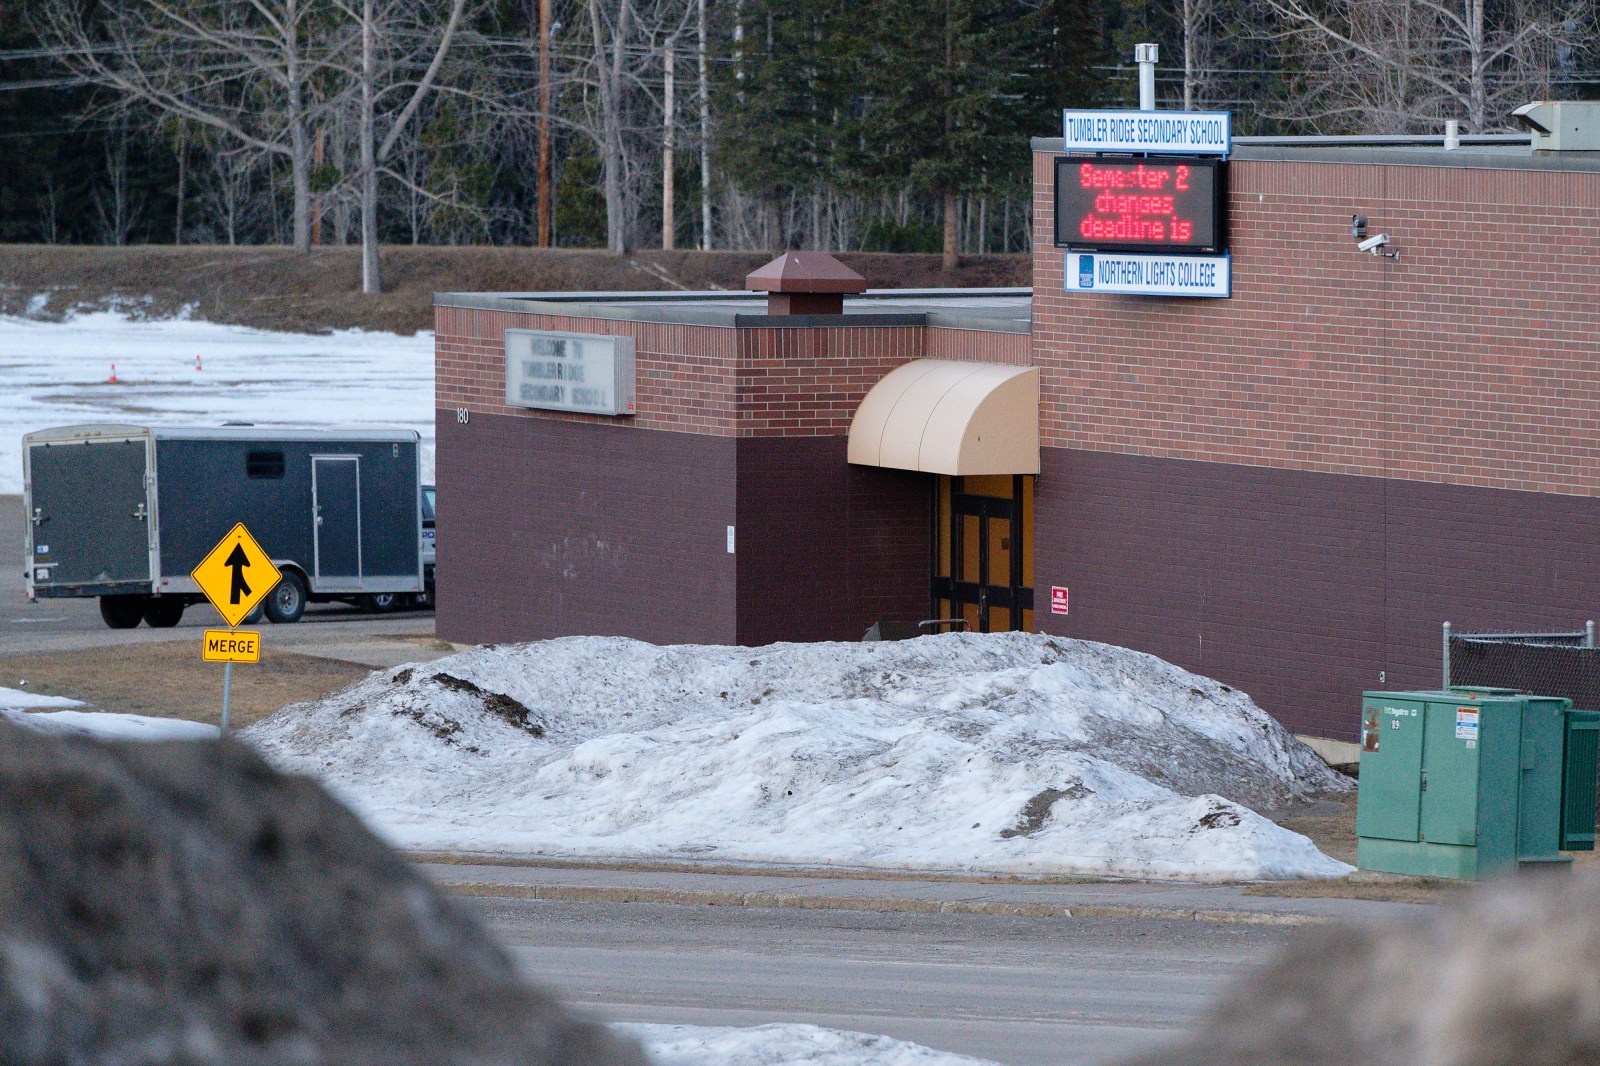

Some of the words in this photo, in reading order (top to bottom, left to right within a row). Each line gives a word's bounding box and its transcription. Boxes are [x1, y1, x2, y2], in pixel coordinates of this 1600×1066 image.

[1068, 118, 1108, 143] TUMBLER
[1110, 119, 1135, 143] RIDGE
[1137, 119, 1188, 144] SECONDARY
[1190, 120, 1224, 145] SCHOOL
[1080, 163, 1170, 190] Semester
[1175, 165, 1190, 190] 2
[1094, 189, 1174, 214] changes
[1080, 213, 1165, 240] deadline
[1169, 216, 1193, 242] is
[1098, 260, 1143, 285] NORTHERN
[1145, 261, 1175, 286] LIGHTS
[1178, 262, 1216, 287] COLLEGE
[456, 407, 469, 424] 180
[208, 639, 255, 654] MERGE
